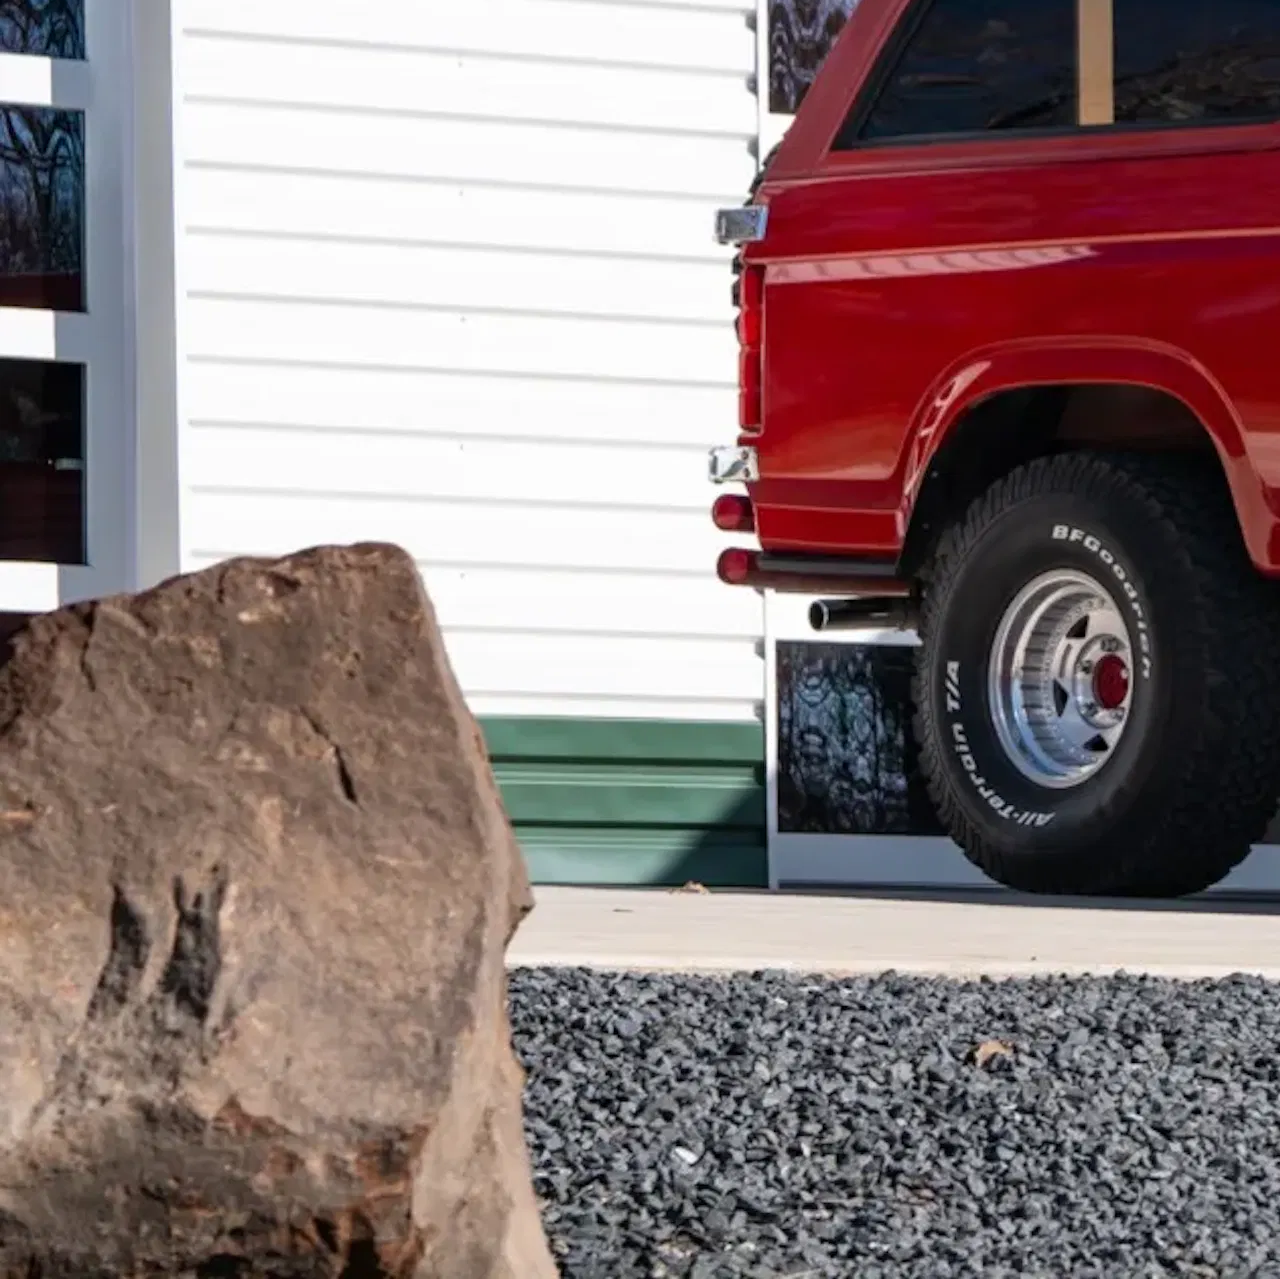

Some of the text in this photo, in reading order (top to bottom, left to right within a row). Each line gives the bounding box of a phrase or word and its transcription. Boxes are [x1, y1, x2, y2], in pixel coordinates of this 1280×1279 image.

[1052, 524, 1151, 679] BFGoodrich
[945, 660, 1057, 827] All-Terrain T/A
